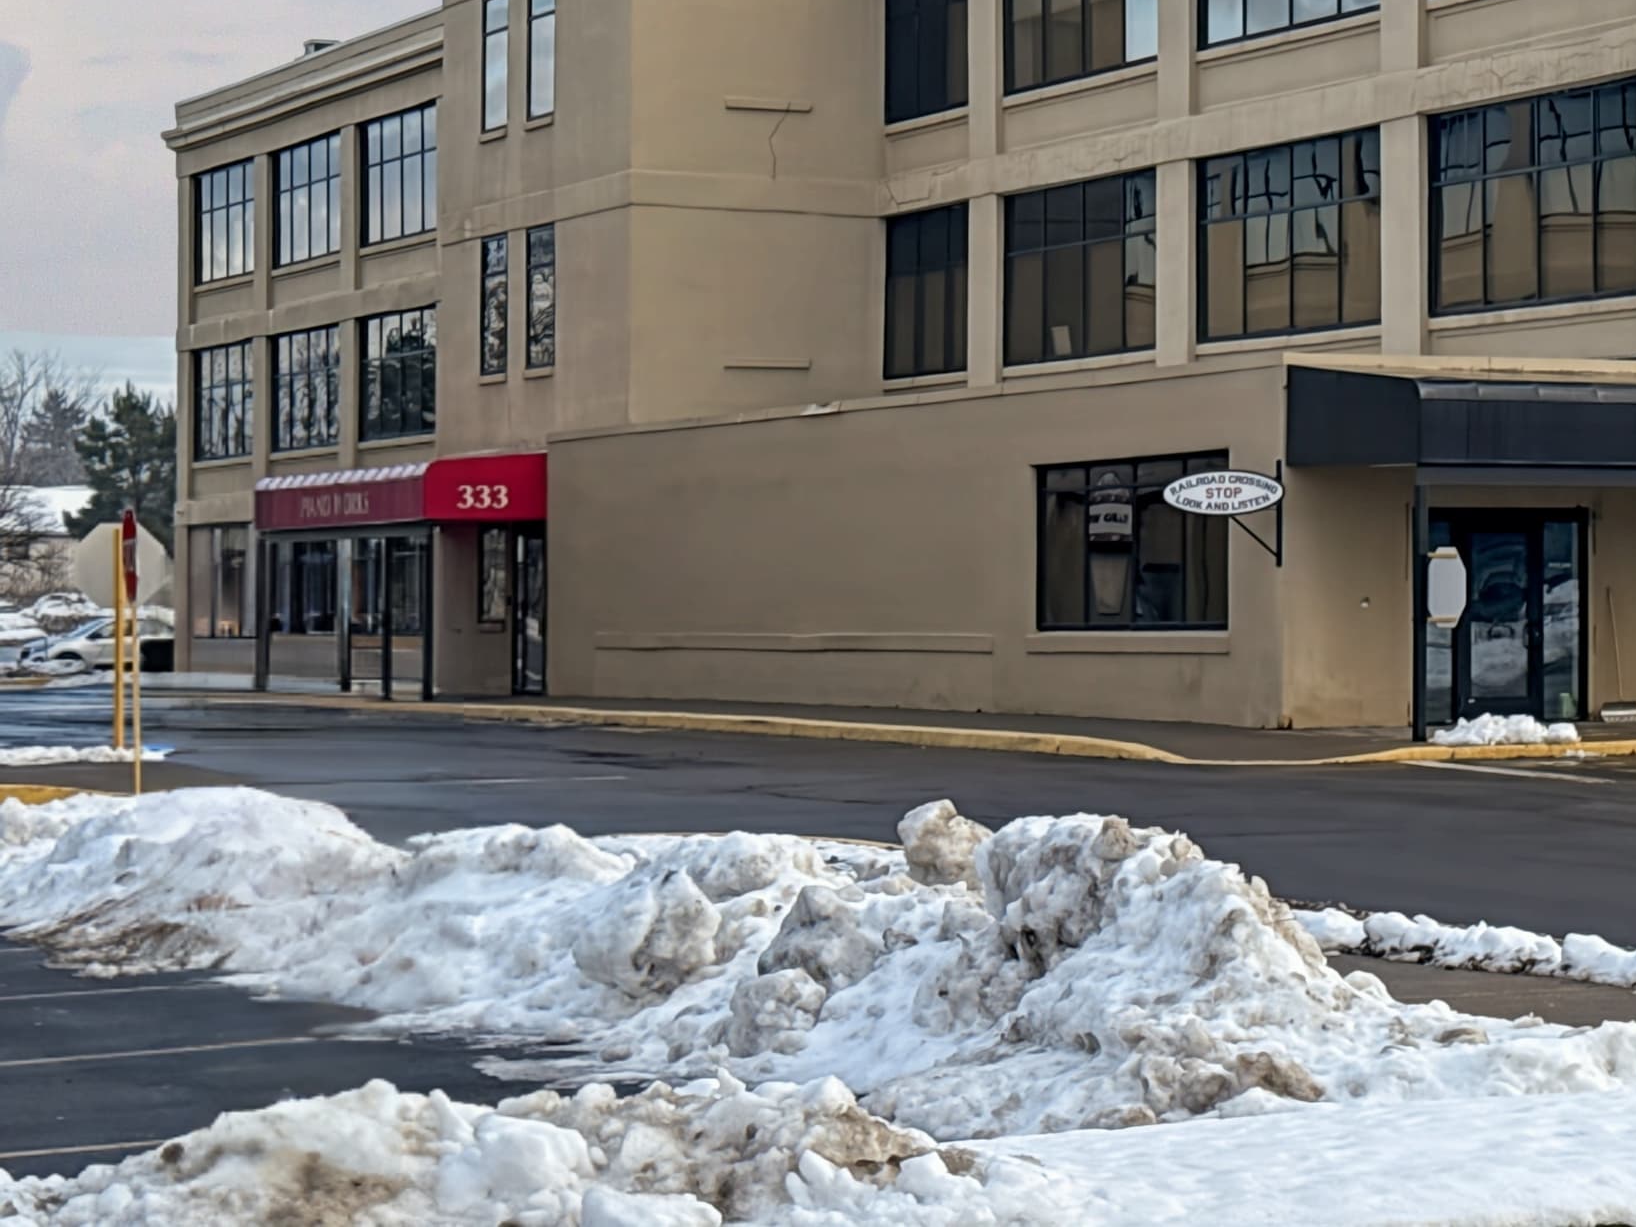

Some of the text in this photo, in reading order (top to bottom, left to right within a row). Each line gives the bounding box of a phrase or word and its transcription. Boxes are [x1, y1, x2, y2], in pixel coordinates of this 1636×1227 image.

[1169, 475, 1278, 495] RAILROAD CROSSING
[1205, 487, 1242, 499] STOP
[456, 484, 508, 509] 333
[1175, 493, 1270, 511] LOOK AND LISTEN
